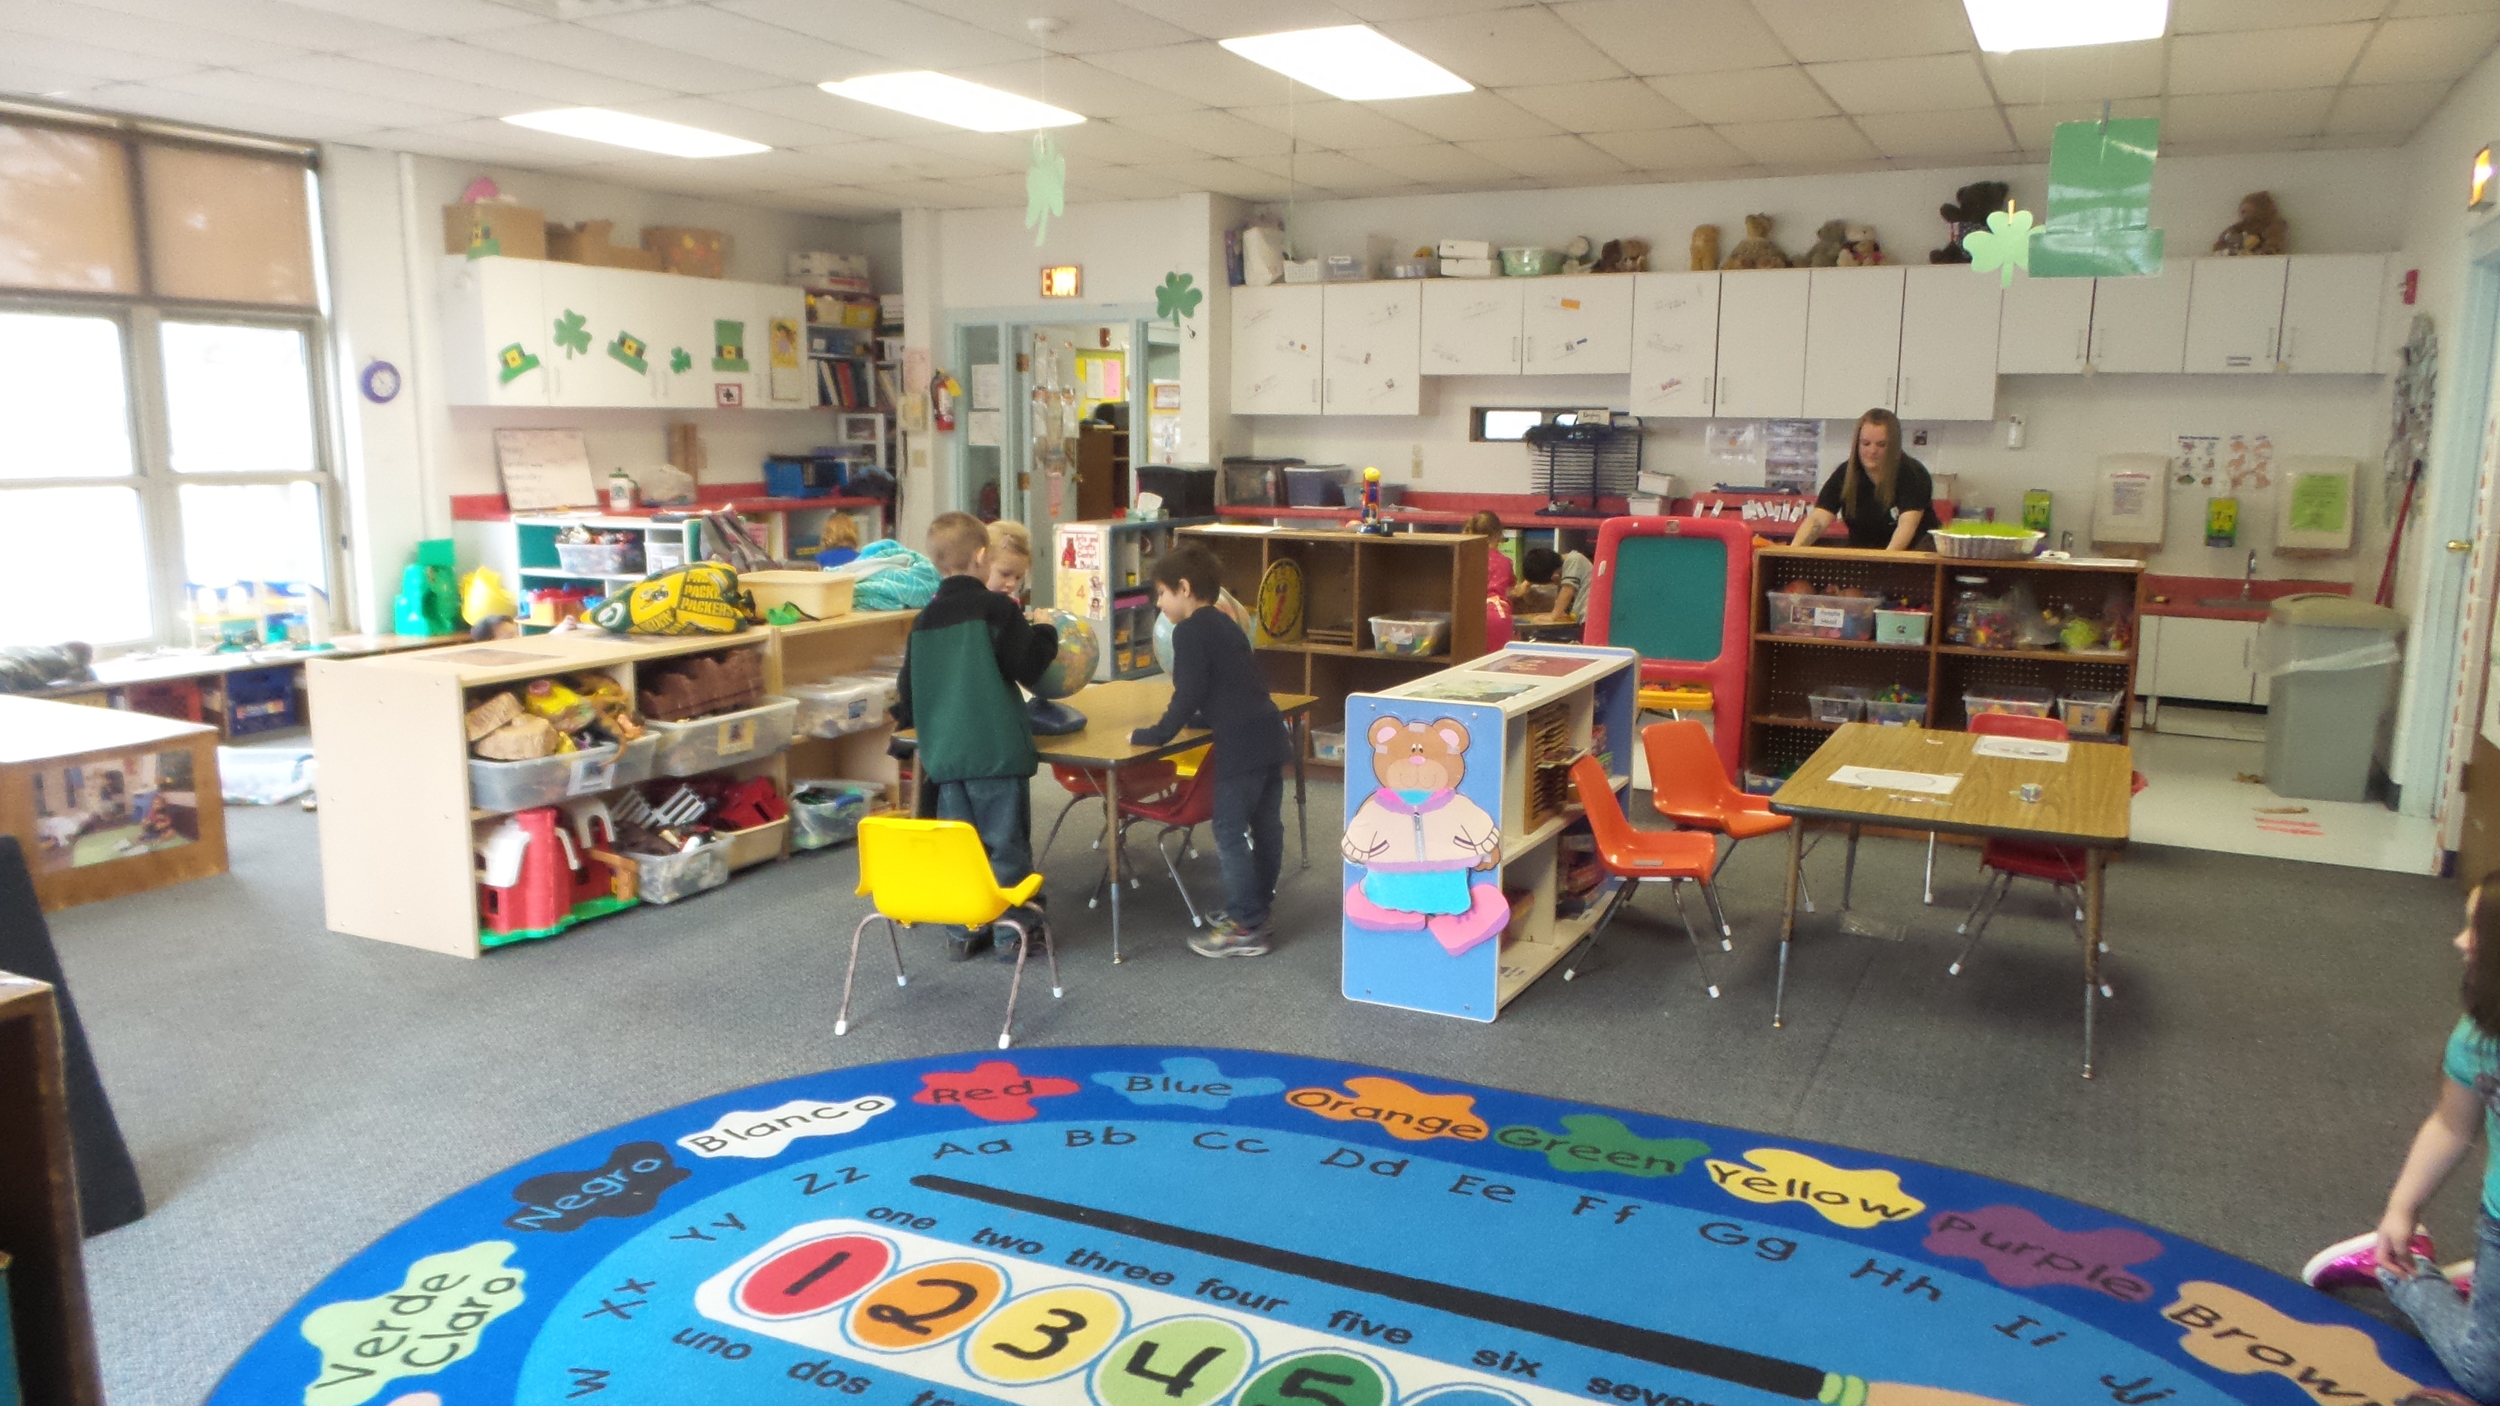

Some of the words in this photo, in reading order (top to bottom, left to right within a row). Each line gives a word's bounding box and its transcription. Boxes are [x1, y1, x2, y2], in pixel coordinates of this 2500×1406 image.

[681, 597, 735, 618] PACKERS
[932, 1079, 1034, 1104] Red
[1126, 1075, 1233, 1097] Blue
[1290, 1090, 1489, 1141] Orange
[689, 1095, 888, 1155] Blanco
[1498, 1126, 1676, 1175] Green
[513, 1157, 663, 1230] Negro
[669, 1212, 747, 1242] Yy
[794, 1166, 869, 1196] Zz
[933, 1138, 1013, 1160] Aa
[1066, 1126, 1137, 1148] Bb
[1193, 1132, 1271, 1154] Cc
[1320, 1148, 1410, 1177] Dd
[1449, 1175, 1516, 1203] Ee
[1571, 1196, 1641, 1224] Ff
[1700, 1222, 1798, 1262] Gg
[1850, 1258, 1943, 1302] Hh
[1711, 1163, 1911, 1220] Yellow
[1938, 1215, 2145, 1300] Purple
[313, 1273, 471, 1389] Verde
[400, 1276, 517, 1369] Claro
[783, 1251, 851, 1296] 1
[867, 1278, 978, 1336] 2
[992, 1308, 1088, 1361] 3
[1124, 1340, 1227, 1399] 4
[1252, 1368, 1355, 1406] 5
[866, 1206, 937, 1230] one
[971, 1227, 1043, 1255] two
[1065, 1247, 1175, 1286] three
[1195, 1278, 1289, 1312] four
[1329, 1309, 1413, 1345] five
[1471, 1346, 1543, 1379] six
[1586, 1377, 1716, 1406] seve
[672, 1327, 753, 1361] uno
[787, 1360, 873, 1396] dos
[2168, 1303, 2385, 1406] Brow
